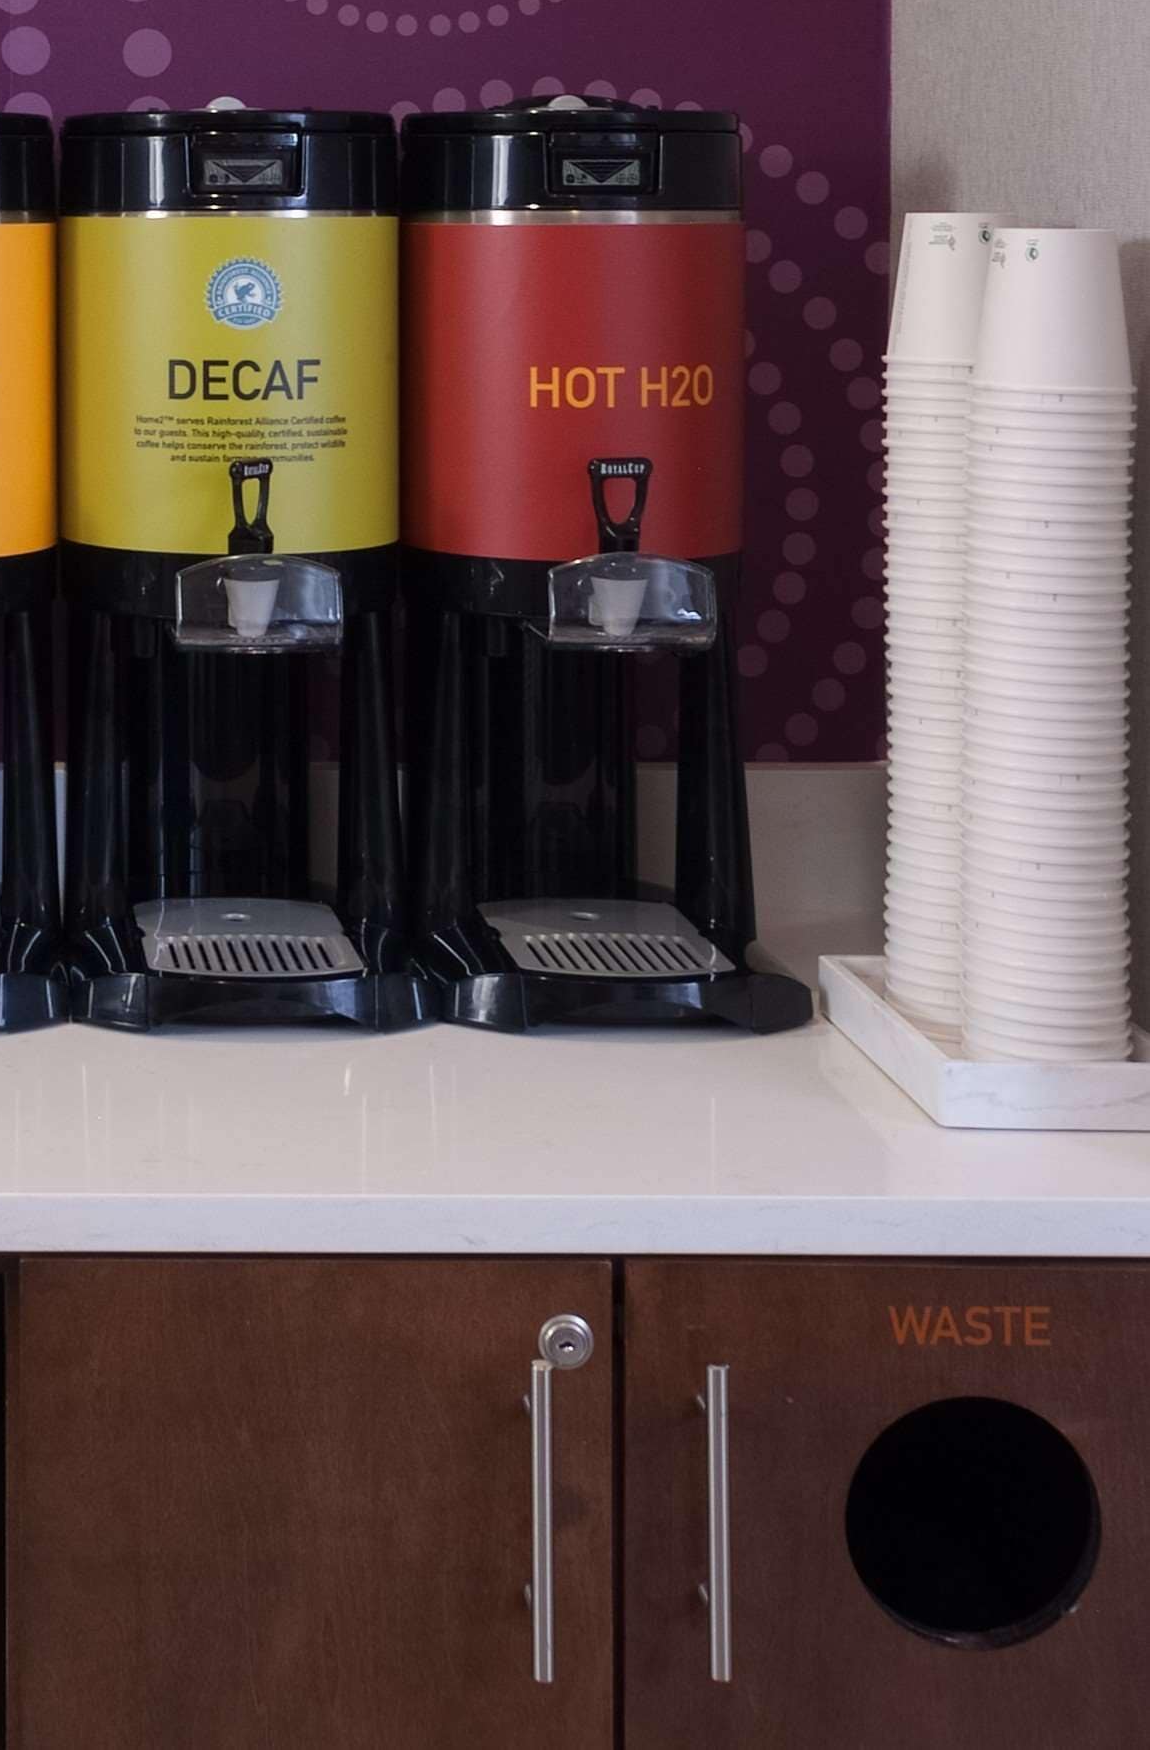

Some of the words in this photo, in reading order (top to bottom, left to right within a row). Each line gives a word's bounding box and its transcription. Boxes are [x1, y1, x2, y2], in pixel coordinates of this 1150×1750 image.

[168, 359, 321, 401] DECAF
[529, 366, 625, 409] HOT
[207, 416, 252, 426] Rainforest
[887, 1305, 1053, 1347] WASTE
